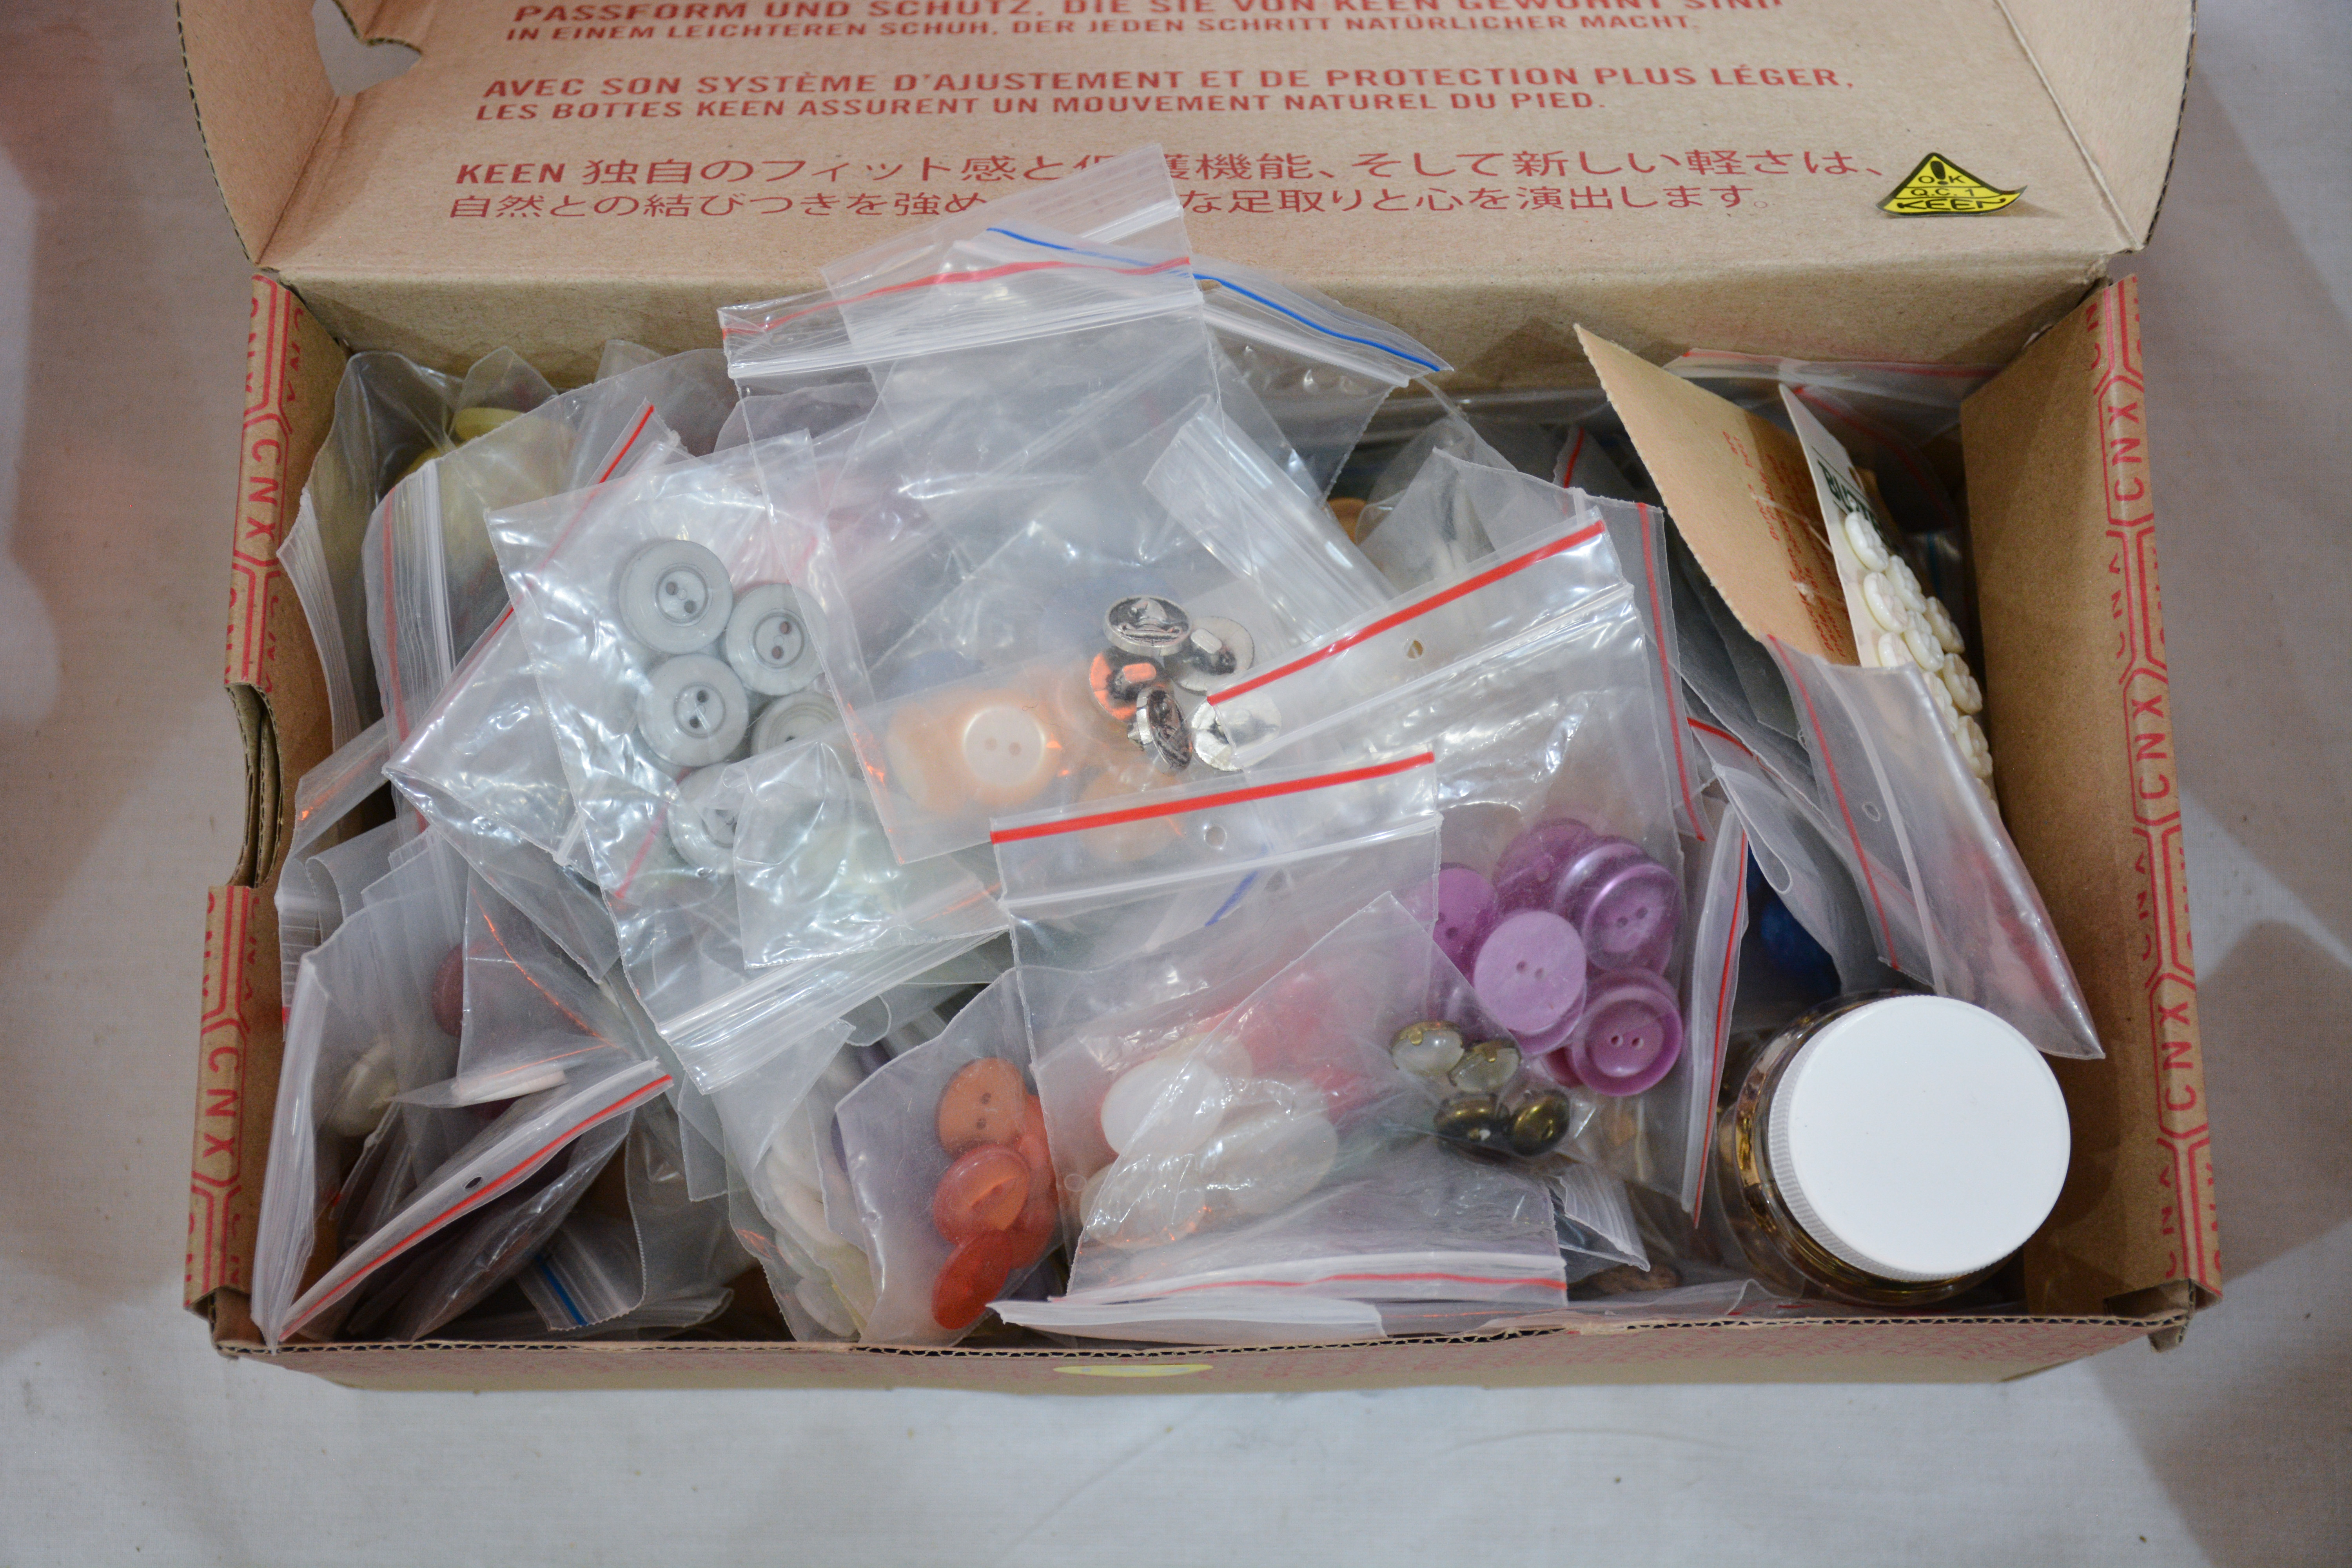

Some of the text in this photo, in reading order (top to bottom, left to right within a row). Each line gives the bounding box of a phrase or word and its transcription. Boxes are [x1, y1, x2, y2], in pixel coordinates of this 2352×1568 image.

[514, 4, 746, 21] PASSFORM
[765, 2, 849, 17] UND
[1064, 0, 1132, 14] DIE
[1151, 0, 1215, 13] SIE
[1231, 0, 1316, 12] VON
[1334, 0, 1438, 11] KEEN
[507, 29, 539, 40] IN
[553, 26, 656, 39] EINEM
[668, 24, 866, 38] LEICHTEREN
[1013, 21, 1074, 33] DER
[1089, 20, 1183, 32] JEDEN
[1199, 18, 1330, 31] SCHRITT
[1346, 15, 1566, 30] NATÜRLICHER
[483, 79, 584, 97] AVEC
[601, 78, 681, 95] SON
[697, 73, 875, 94] SYSTÈME
[1200, 70, 1243, 88] ET
[1260, 70, 1309, 87] DE
[1327, 68, 1578, 87] PROTECTION
[1594, 67, 1697, 85] PLUS
[1711, 64, 1853, 89] LÉGER,
[476, 93, 1604, 120] LES BOTTES KEEN ASSURENT UN MOUVEMENT NATUREL DU PIED.
[456, 163, 565, 184] KEEN
[1897, 198, 2006, 211] KEEN
[2107, 399, 2145, 503] CNX
[245, 437, 281, 543] CNX
[2131, 693, 2170, 800] CNX
[2157, 1001, 2197, 1112] CNX
[203, 1045, 240, 1160] CNX
